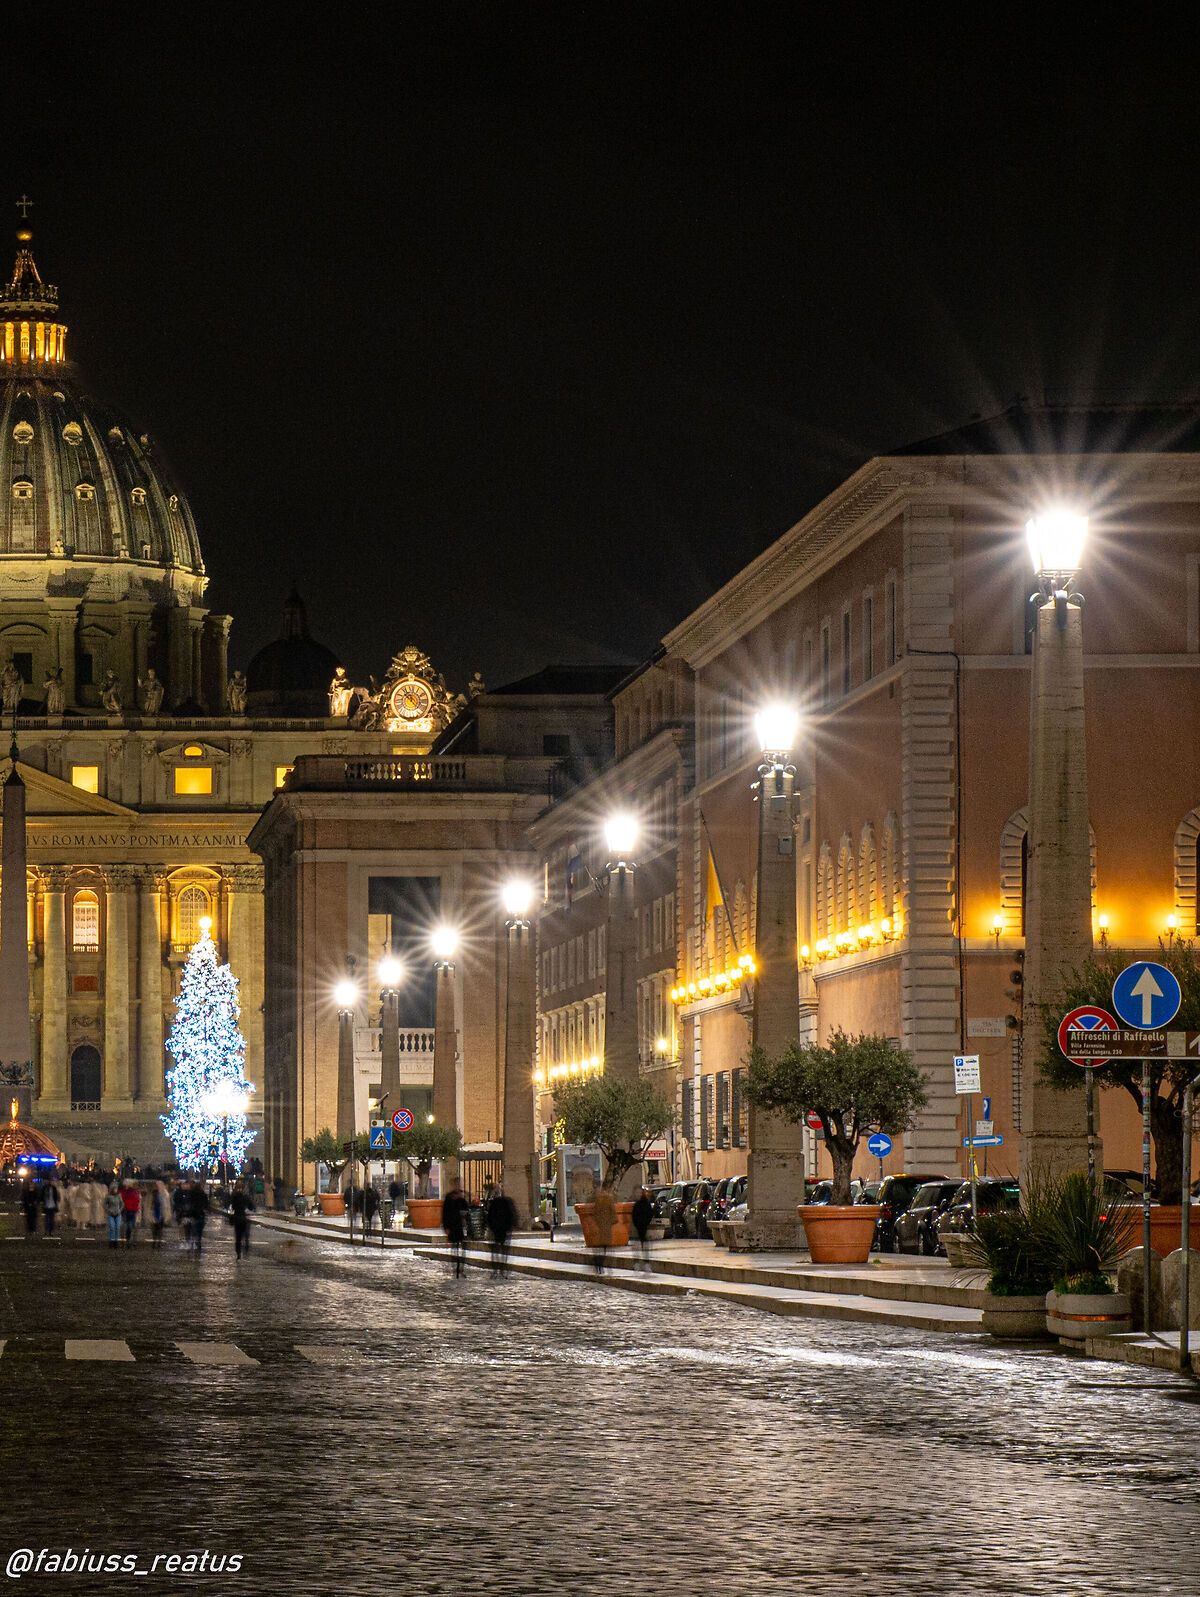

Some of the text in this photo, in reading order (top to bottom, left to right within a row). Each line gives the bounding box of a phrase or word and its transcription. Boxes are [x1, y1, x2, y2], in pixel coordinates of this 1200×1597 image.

[51, 834, 126, 846] ROMANVS
[1070, 1031, 1165, 1041] Affreschi di Raffaello
